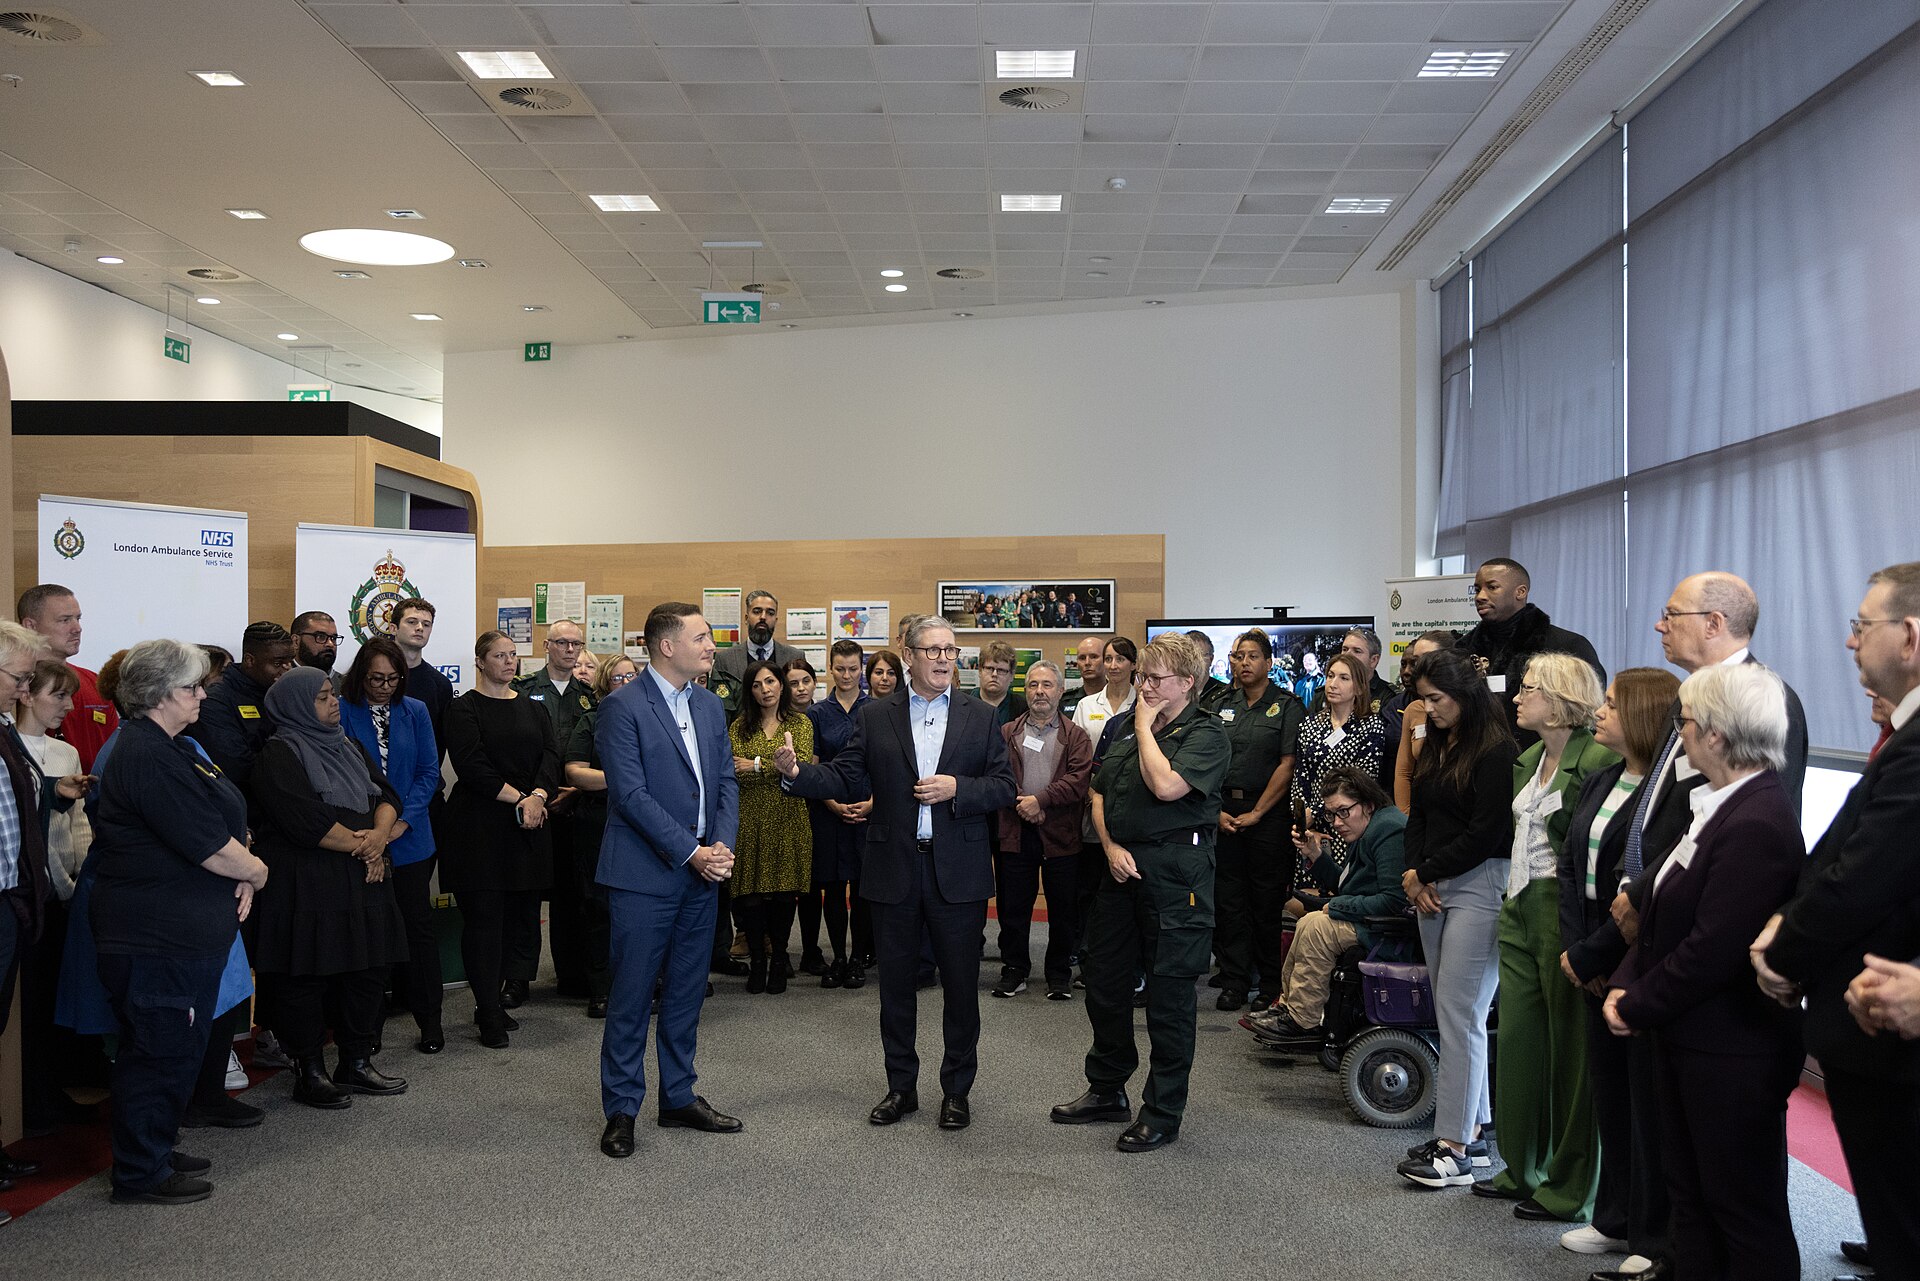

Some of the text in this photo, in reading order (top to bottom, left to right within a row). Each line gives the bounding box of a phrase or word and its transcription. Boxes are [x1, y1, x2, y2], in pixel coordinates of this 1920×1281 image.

[202, 531, 233, 546] NHS
[114, 543, 233, 558] London Ambulance Service
[371, 592, 404, 608] AMBULAN
[1424, 620, 1448, 628] capital's
[1393, 643, 1406, 653] Ou
